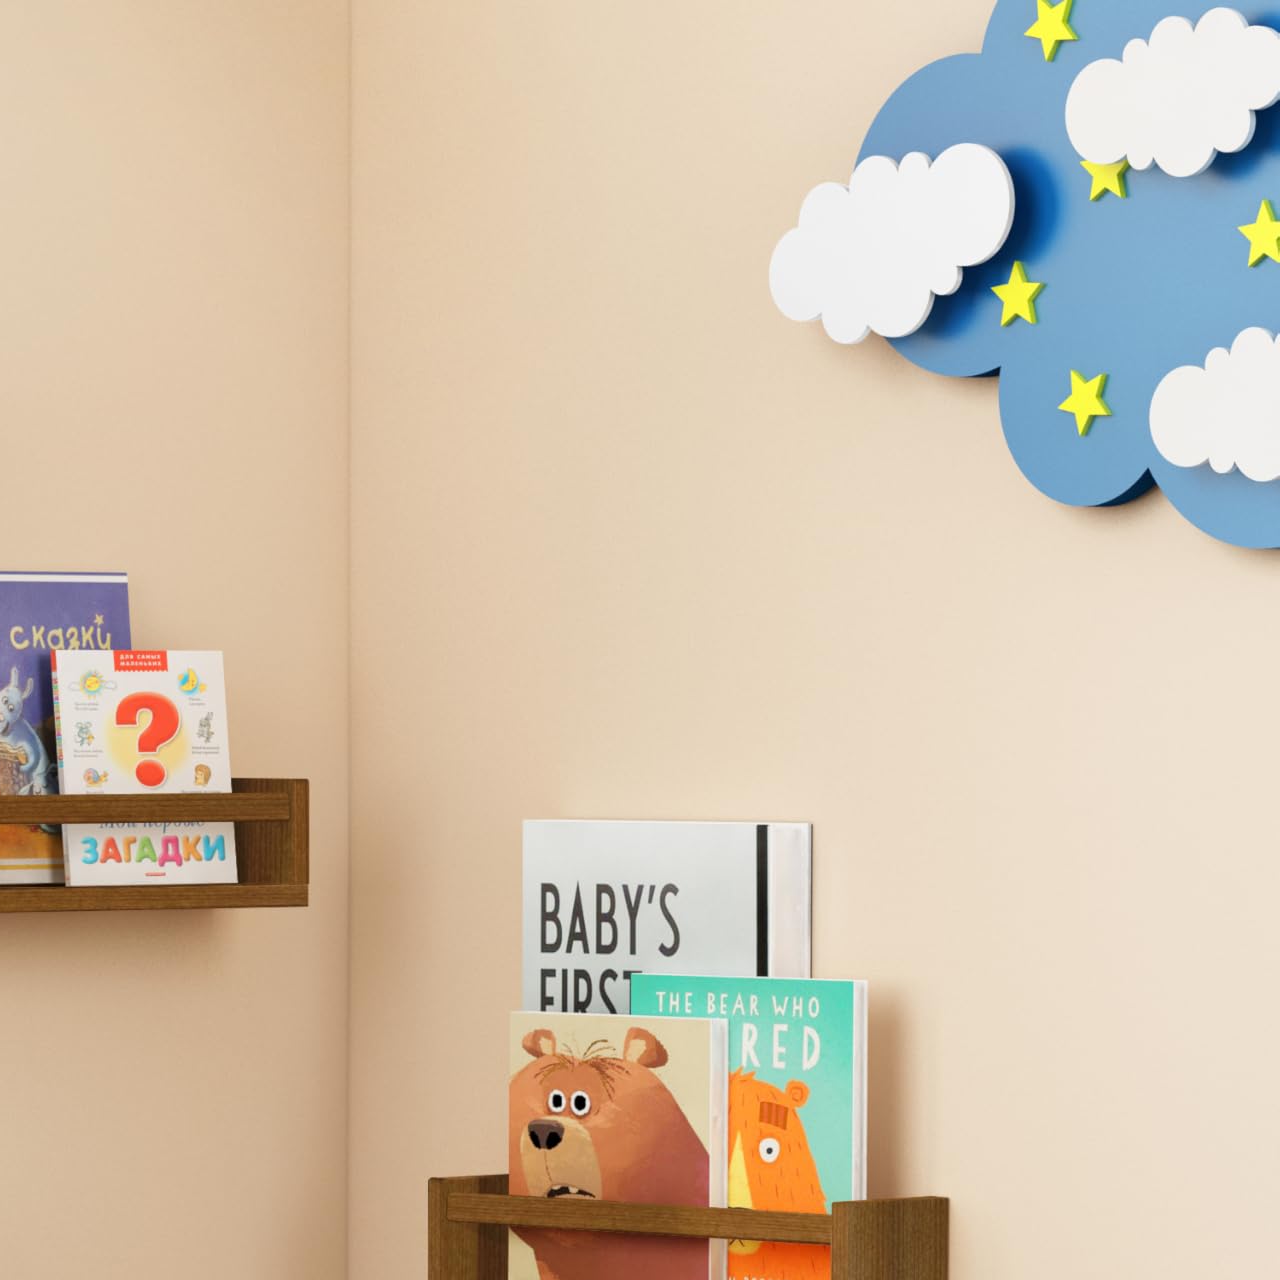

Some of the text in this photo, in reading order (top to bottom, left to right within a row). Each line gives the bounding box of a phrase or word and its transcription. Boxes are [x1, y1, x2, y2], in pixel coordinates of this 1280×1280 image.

[80, 834, 226, 867] ЗАГАДКИ
[540, 881, 681, 957] BABY'S
[656, 991, 820, 1018] THE BEAR WHO
